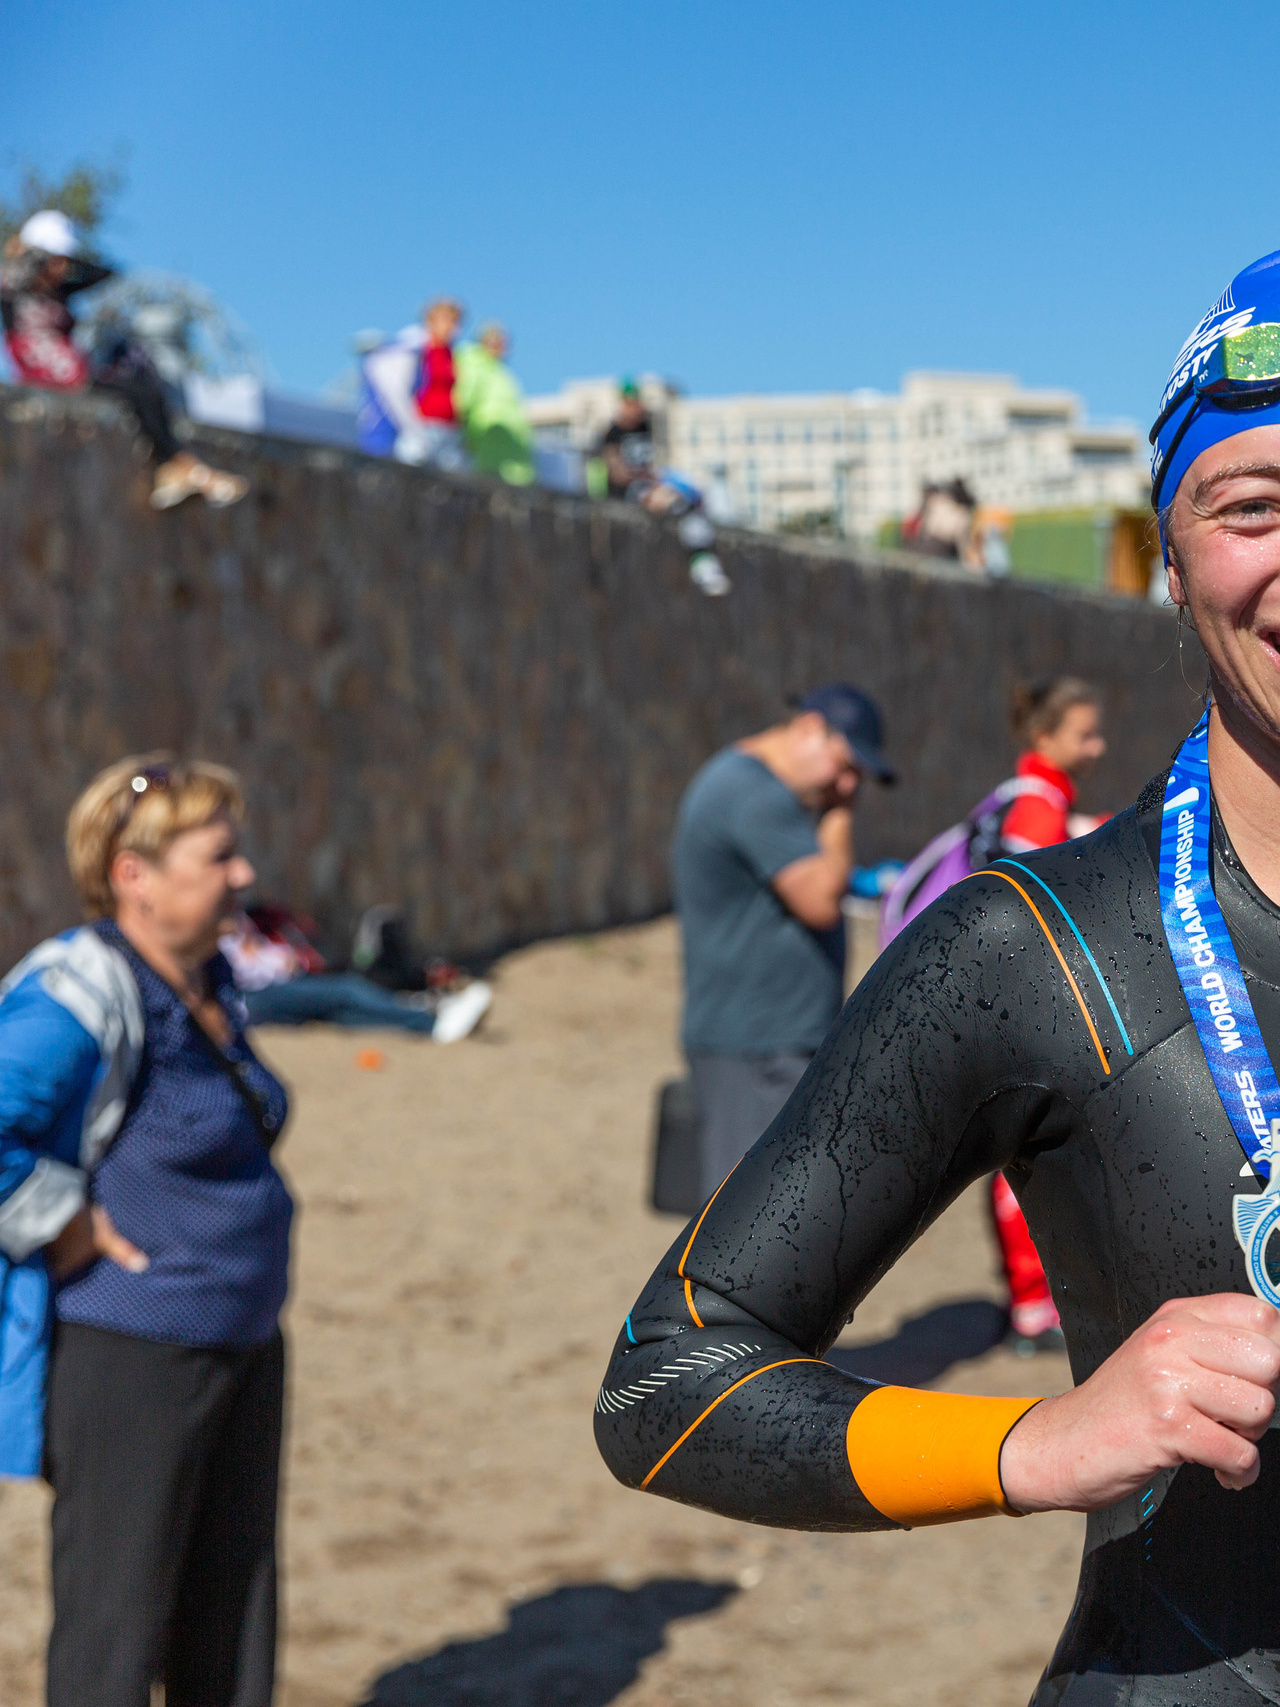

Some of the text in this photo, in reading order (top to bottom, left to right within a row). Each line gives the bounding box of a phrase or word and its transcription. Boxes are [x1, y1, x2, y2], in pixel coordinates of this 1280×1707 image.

[1174, 809, 1272, 1151] ATERS WORLD CHAMPIONSHIP
[1252, 1238, 1260, 1260] WORLD
[1253, 1260, 1280, 1304] CHAMPIONSHIP
